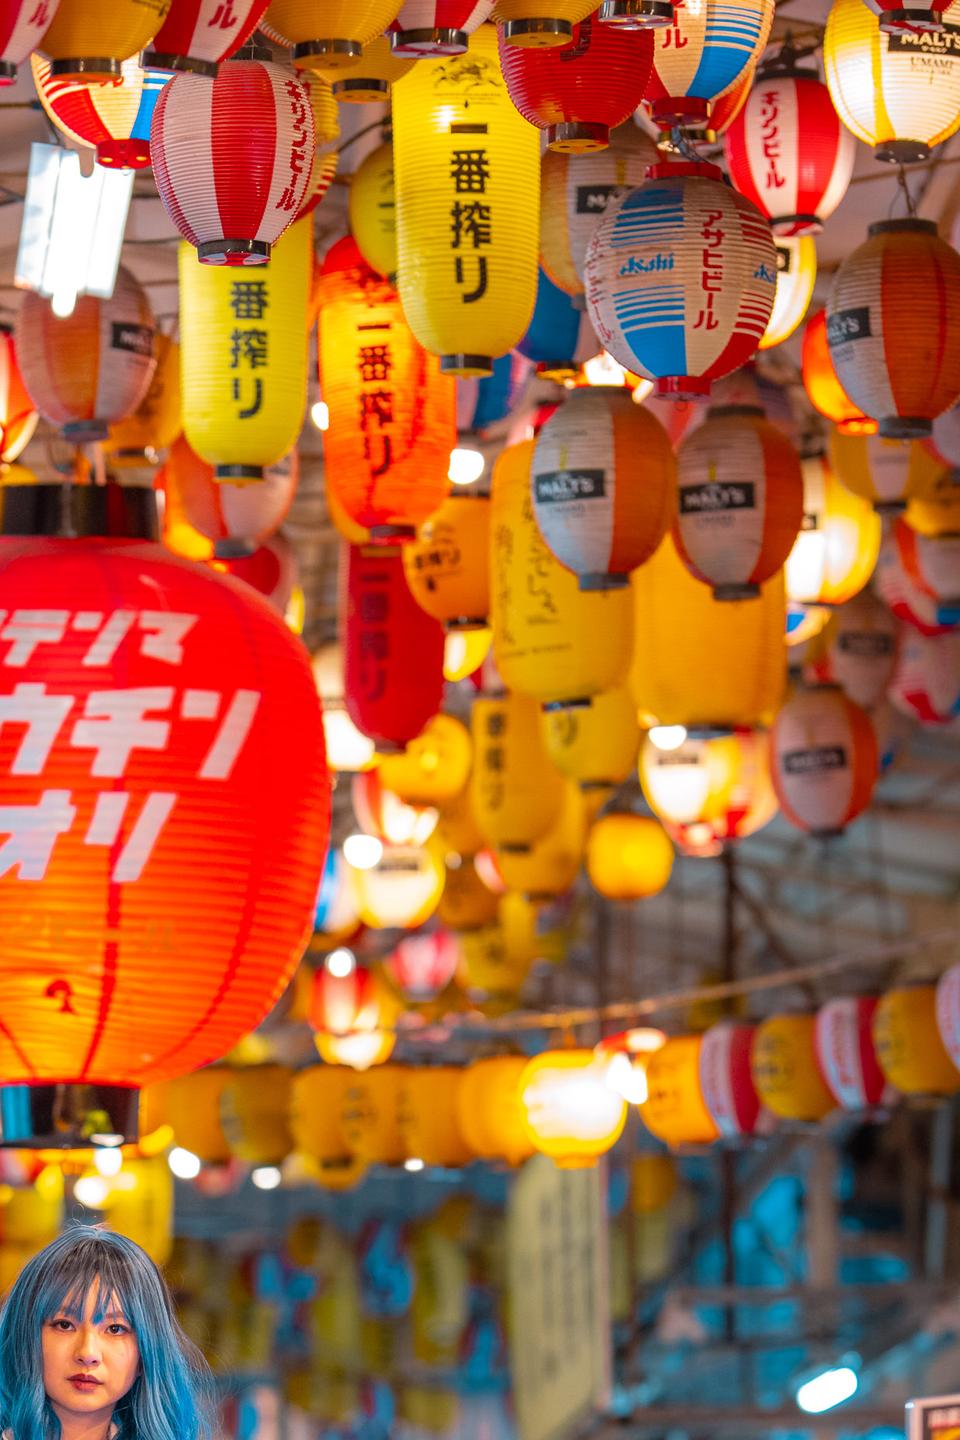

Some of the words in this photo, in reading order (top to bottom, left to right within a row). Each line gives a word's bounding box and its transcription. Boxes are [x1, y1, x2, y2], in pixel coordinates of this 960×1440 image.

[276, 80, 308, 211] キリンビール
[760, 91, 786, 189] キリンビール
[450, 123, 492, 302] 一番搾り
[619, 252, 675, 275] Asahi
[693, 210, 726, 331] アサヒビール
[357, 323, 392, 476] 一番搾り
